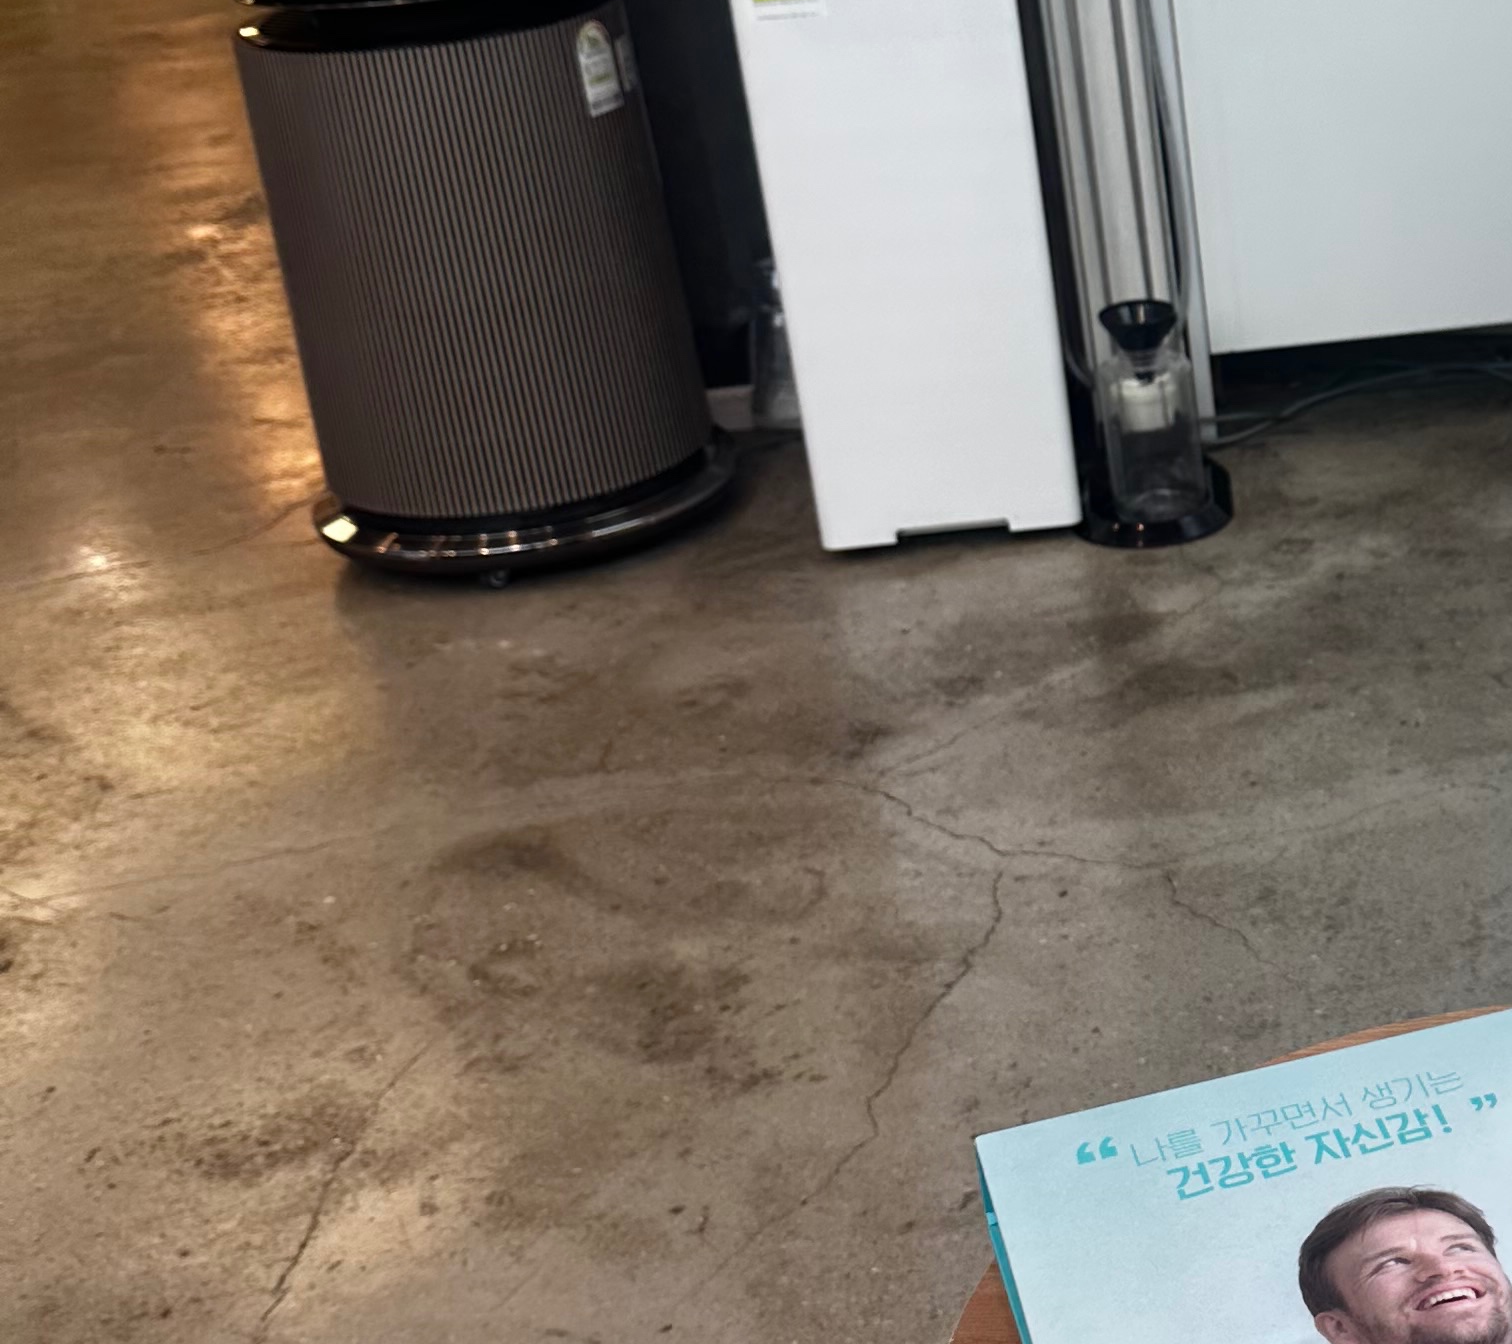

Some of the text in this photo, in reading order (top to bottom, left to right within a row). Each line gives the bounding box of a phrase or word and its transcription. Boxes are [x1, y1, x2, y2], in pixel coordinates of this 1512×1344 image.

[1129, 1127, 1205, 1167] 나를
[1211, 1092, 1353, 1147] 가꾸면서
[1361, 1071, 1464, 1111] 생기는
[1166, 1143, 1298, 1200] 건강한
[1305, 1103, 1453, 1165] 자신감!
